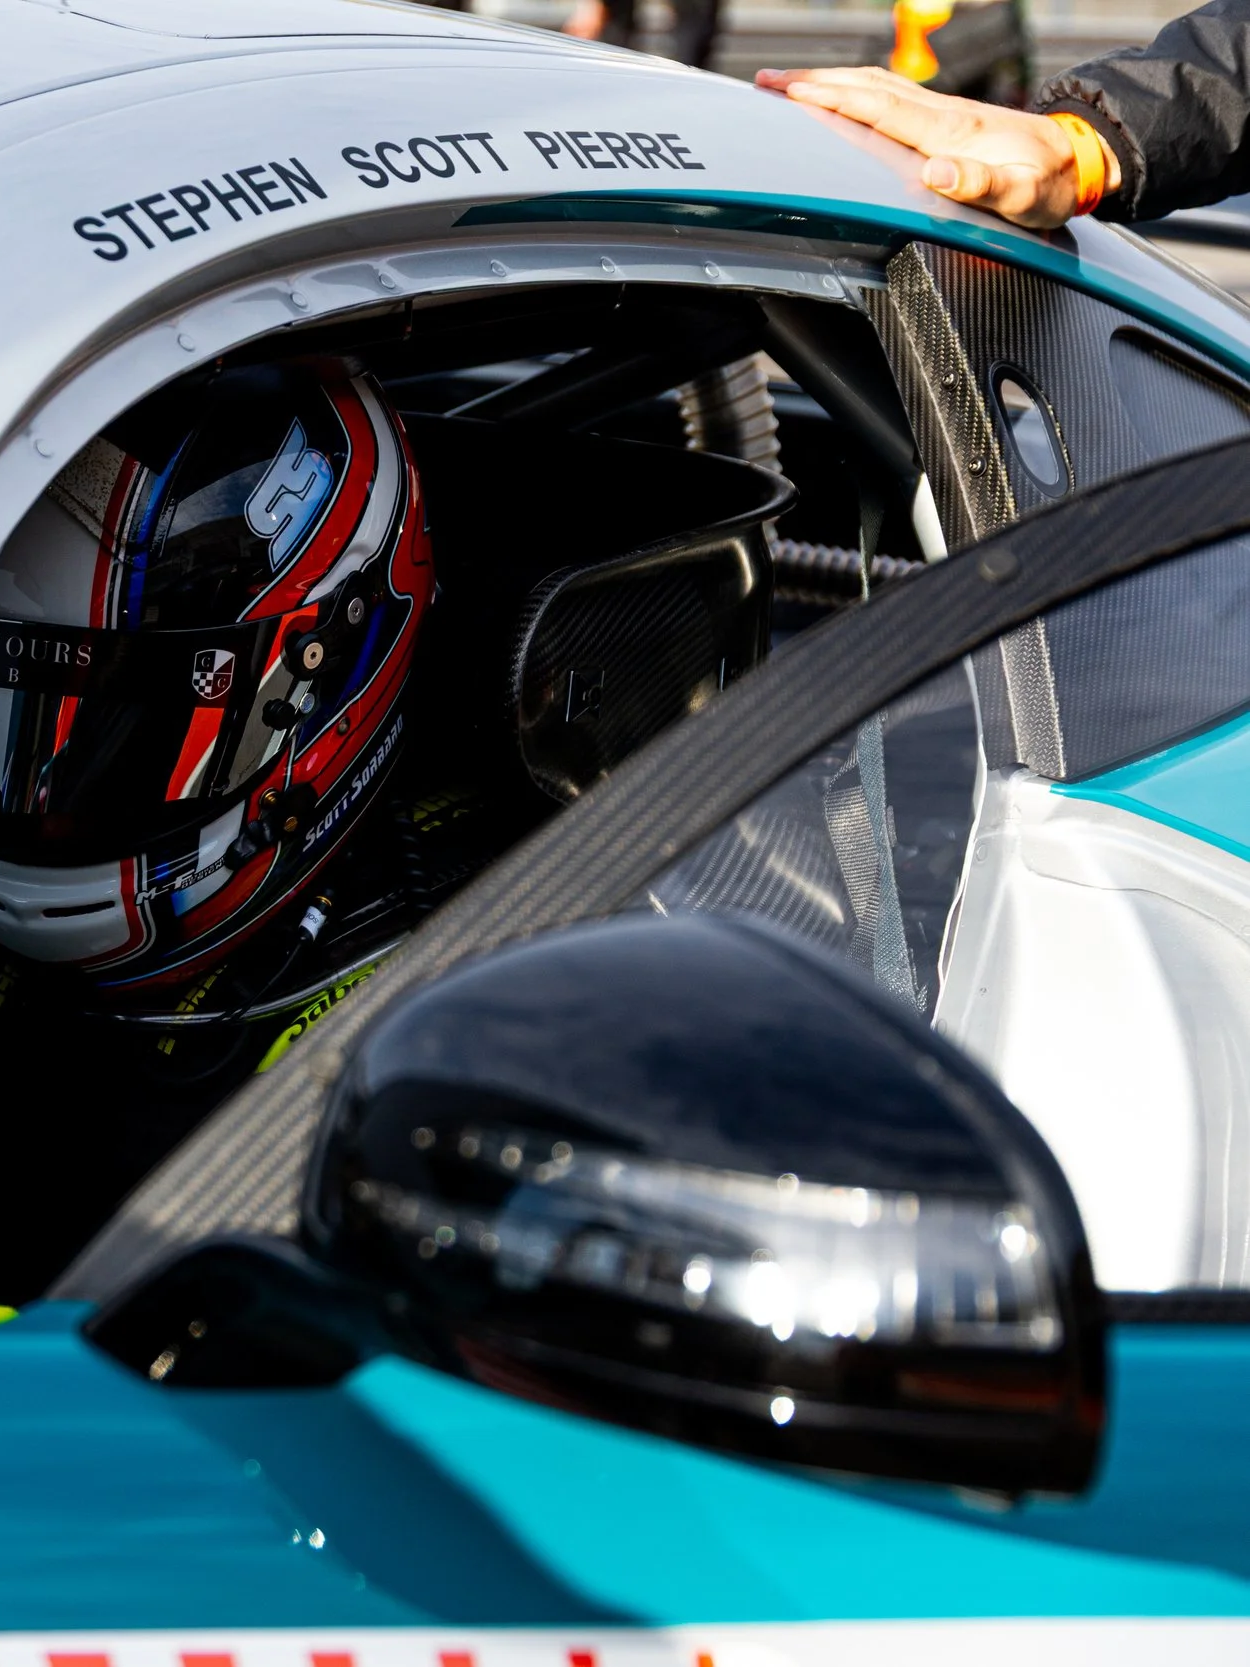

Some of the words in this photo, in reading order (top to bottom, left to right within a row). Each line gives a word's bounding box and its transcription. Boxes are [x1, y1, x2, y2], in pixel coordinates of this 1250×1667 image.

[73, 157, 328, 263] STEPHEN
[340, 131, 510, 189] SCOTT
[524, 130, 706, 171] PIERRE
